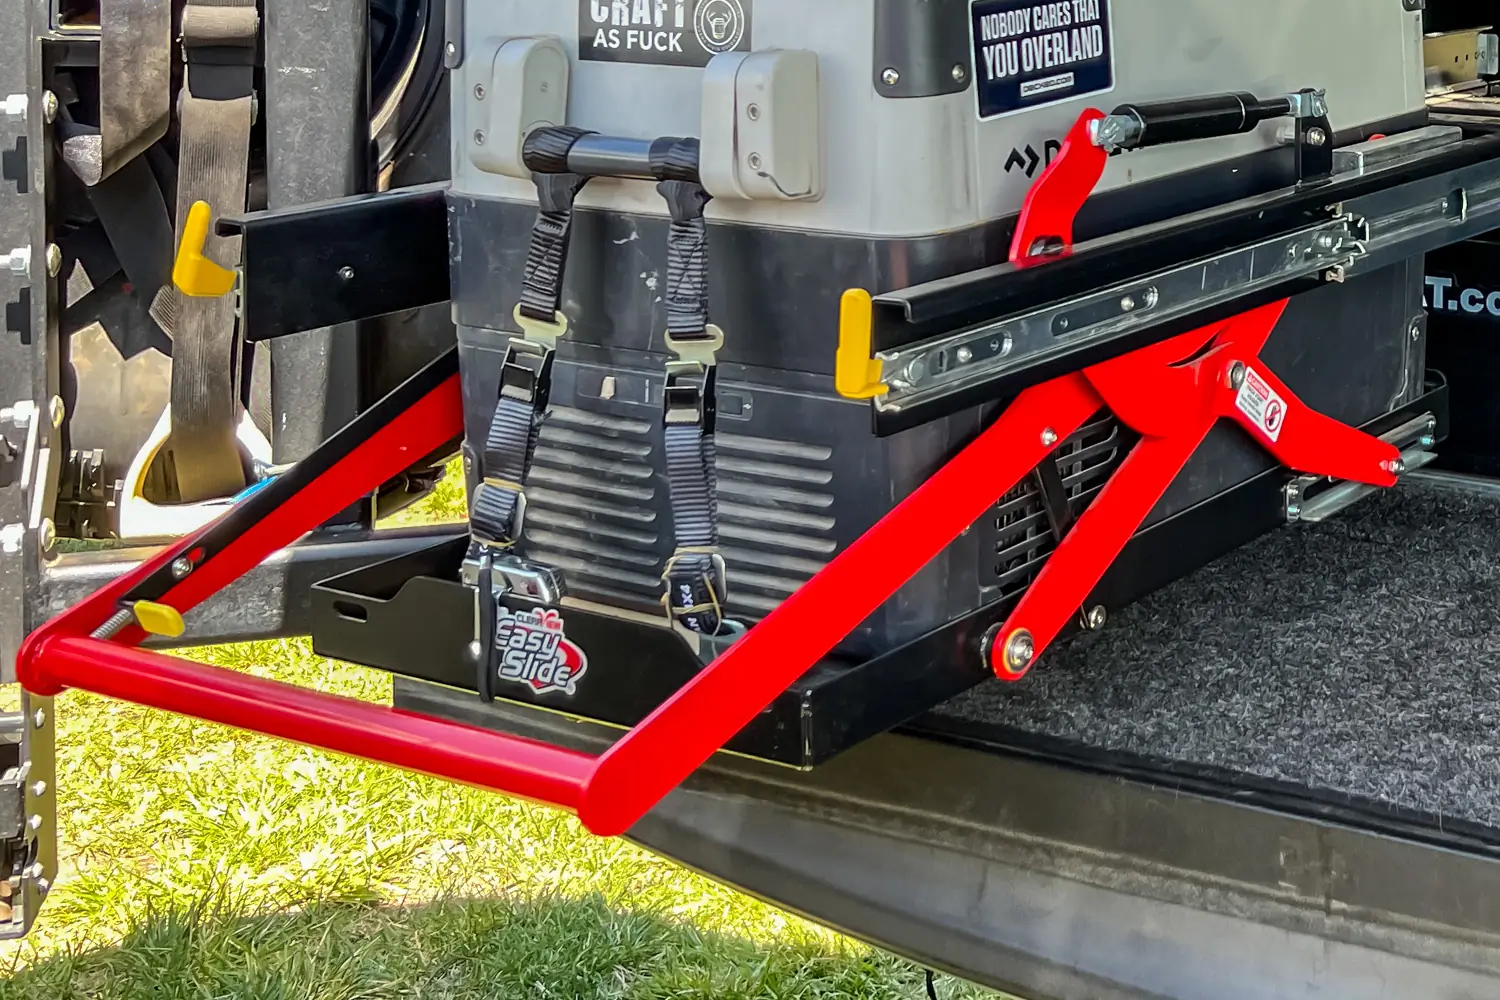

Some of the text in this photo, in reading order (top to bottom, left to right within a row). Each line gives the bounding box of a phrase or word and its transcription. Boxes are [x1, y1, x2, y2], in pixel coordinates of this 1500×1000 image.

[592, 28, 683, 53] AS FUCK
[981, 7, 1031, 41] NOBODY
[1033, 0, 1071, 31] CARES
[982, 24, 1104, 80] YOU OVERLAND
[496, 617, 562, 661] Easy
[501, 650, 572, 687] Slide
